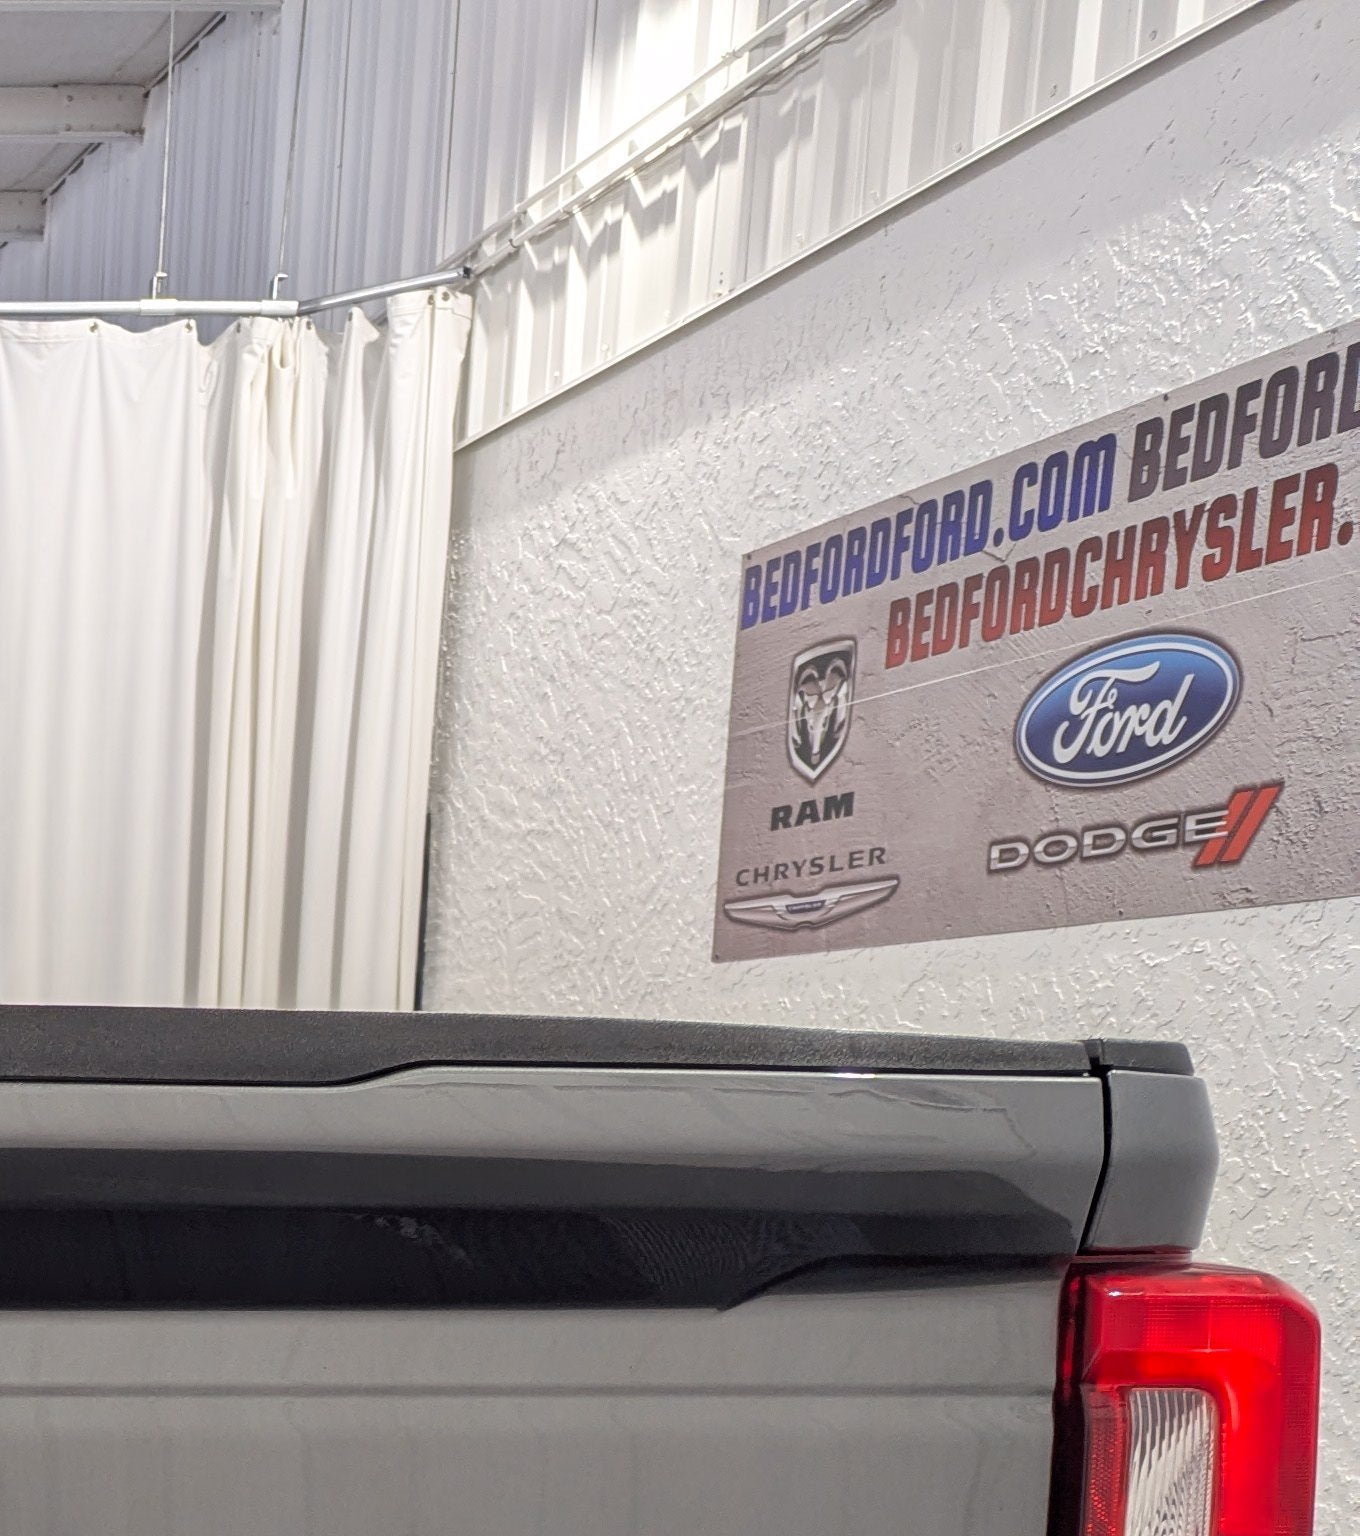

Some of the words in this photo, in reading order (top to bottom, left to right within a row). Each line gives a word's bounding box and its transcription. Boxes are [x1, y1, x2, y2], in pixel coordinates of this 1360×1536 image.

[741, 432, 1117, 630] BEDFORDFORD.COM
[884, 462, 1354, 669] BEDFORDCHRYSLER.
[1052, 659, 1195, 764] Ford
[770, 790, 856, 832] RAM
[987, 808, 1231, 873] DODGE
[735, 846, 887, 887] CHRYSLER
